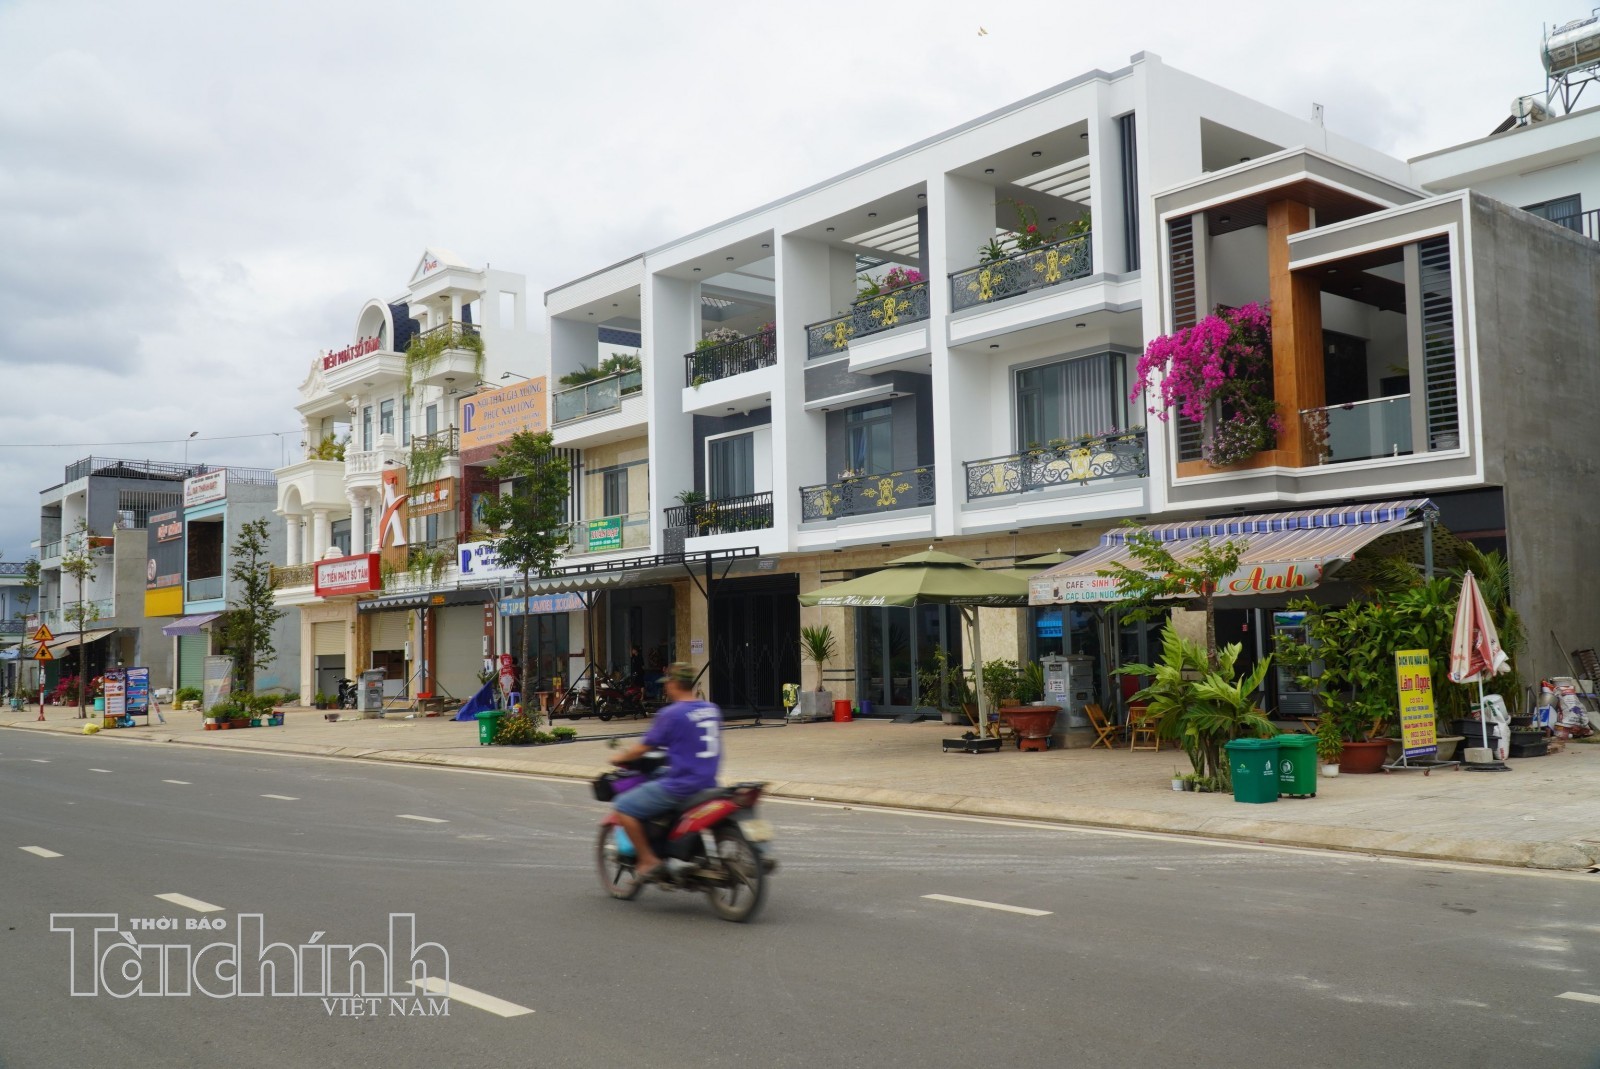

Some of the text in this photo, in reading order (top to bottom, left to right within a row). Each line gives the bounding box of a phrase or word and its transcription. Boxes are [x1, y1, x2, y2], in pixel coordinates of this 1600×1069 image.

[1091, 579, 1109, 588] SINH
[1229, 565, 1309, 592] Anh
[695, 719, 720, 759] 3
